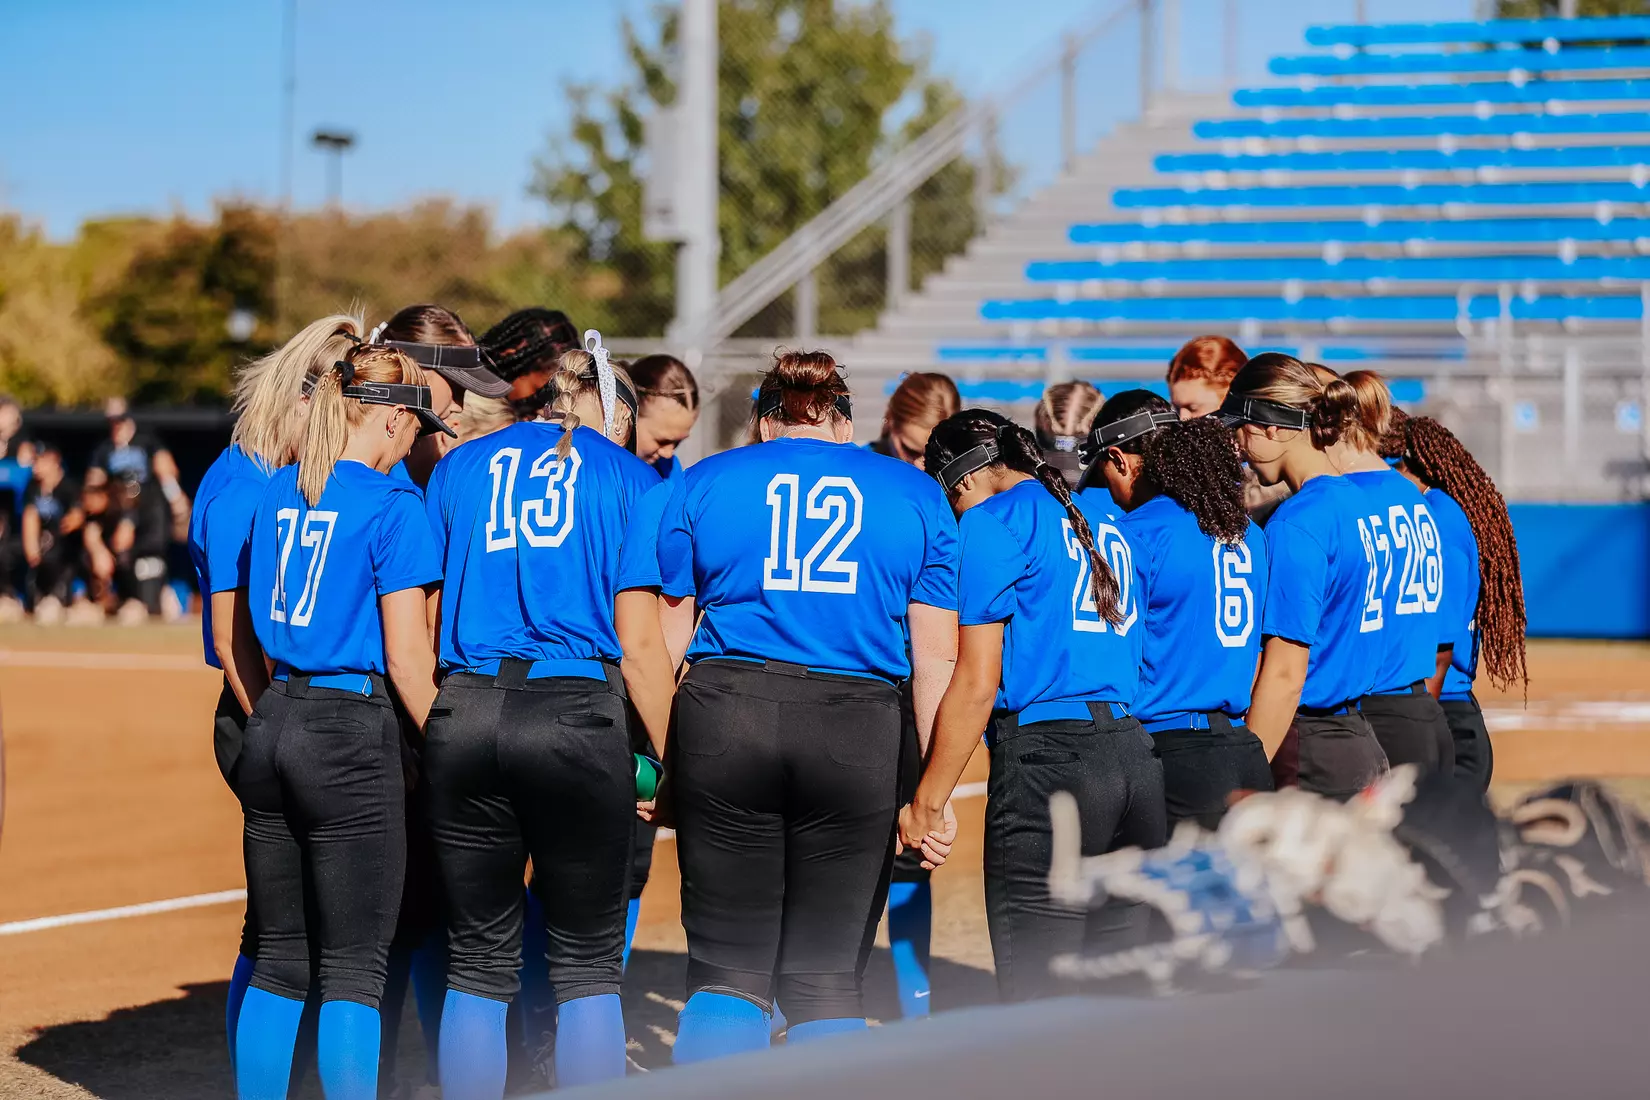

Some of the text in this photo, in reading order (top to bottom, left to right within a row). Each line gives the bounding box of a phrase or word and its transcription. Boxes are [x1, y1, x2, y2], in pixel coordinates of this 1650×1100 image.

[486, 446, 582, 553] 13
[763, 474, 863, 594] 12
[270, 507, 338, 627] 17
[1061, 518, 1138, 637] 20
[1212, 537, 1254, 647] 6
[1388, 504, 1443, 615] 28
